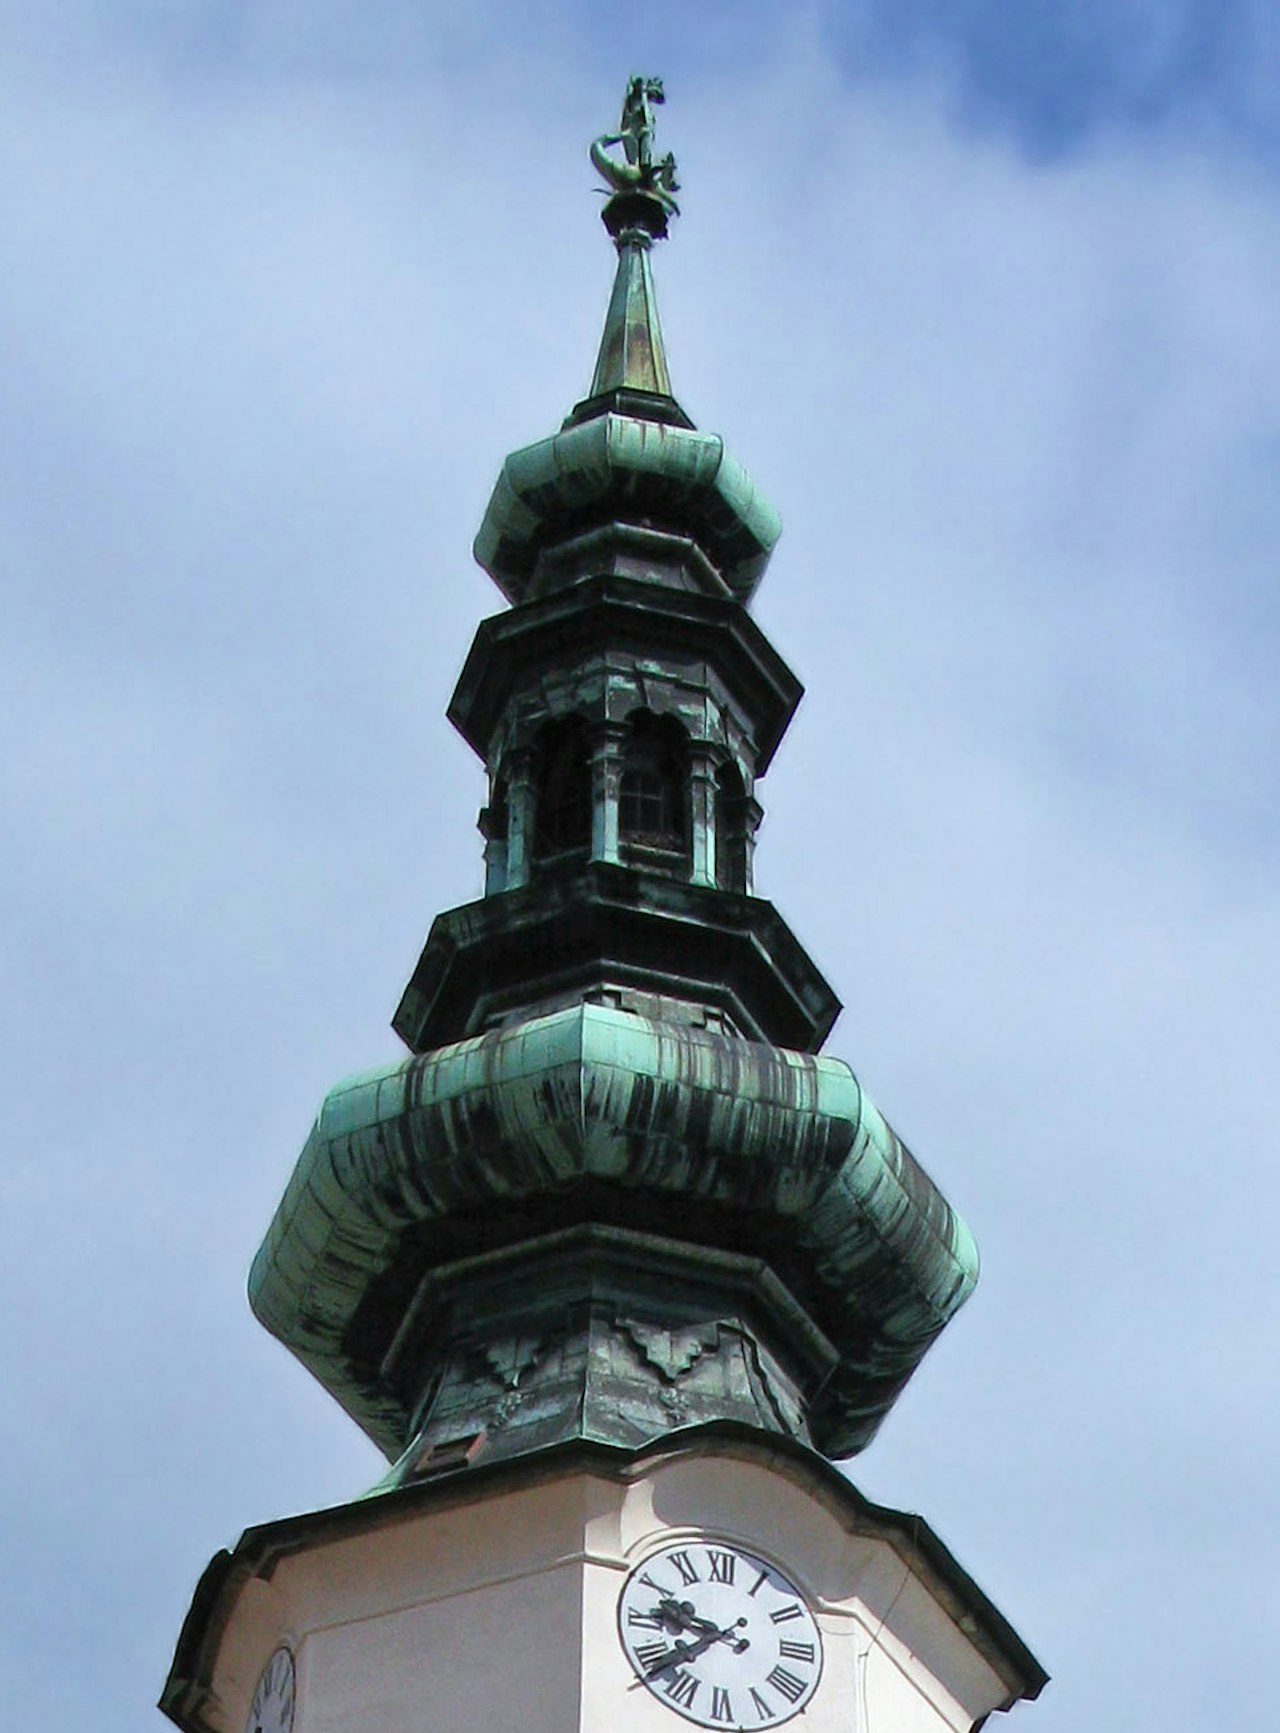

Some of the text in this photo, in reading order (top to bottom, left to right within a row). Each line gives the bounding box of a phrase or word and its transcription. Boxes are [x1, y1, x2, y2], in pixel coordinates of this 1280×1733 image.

[668, 1551, 700, 1586] XI
[707, 1550, 736, 1585] XII
[780, 1639, 815, 1664] III
